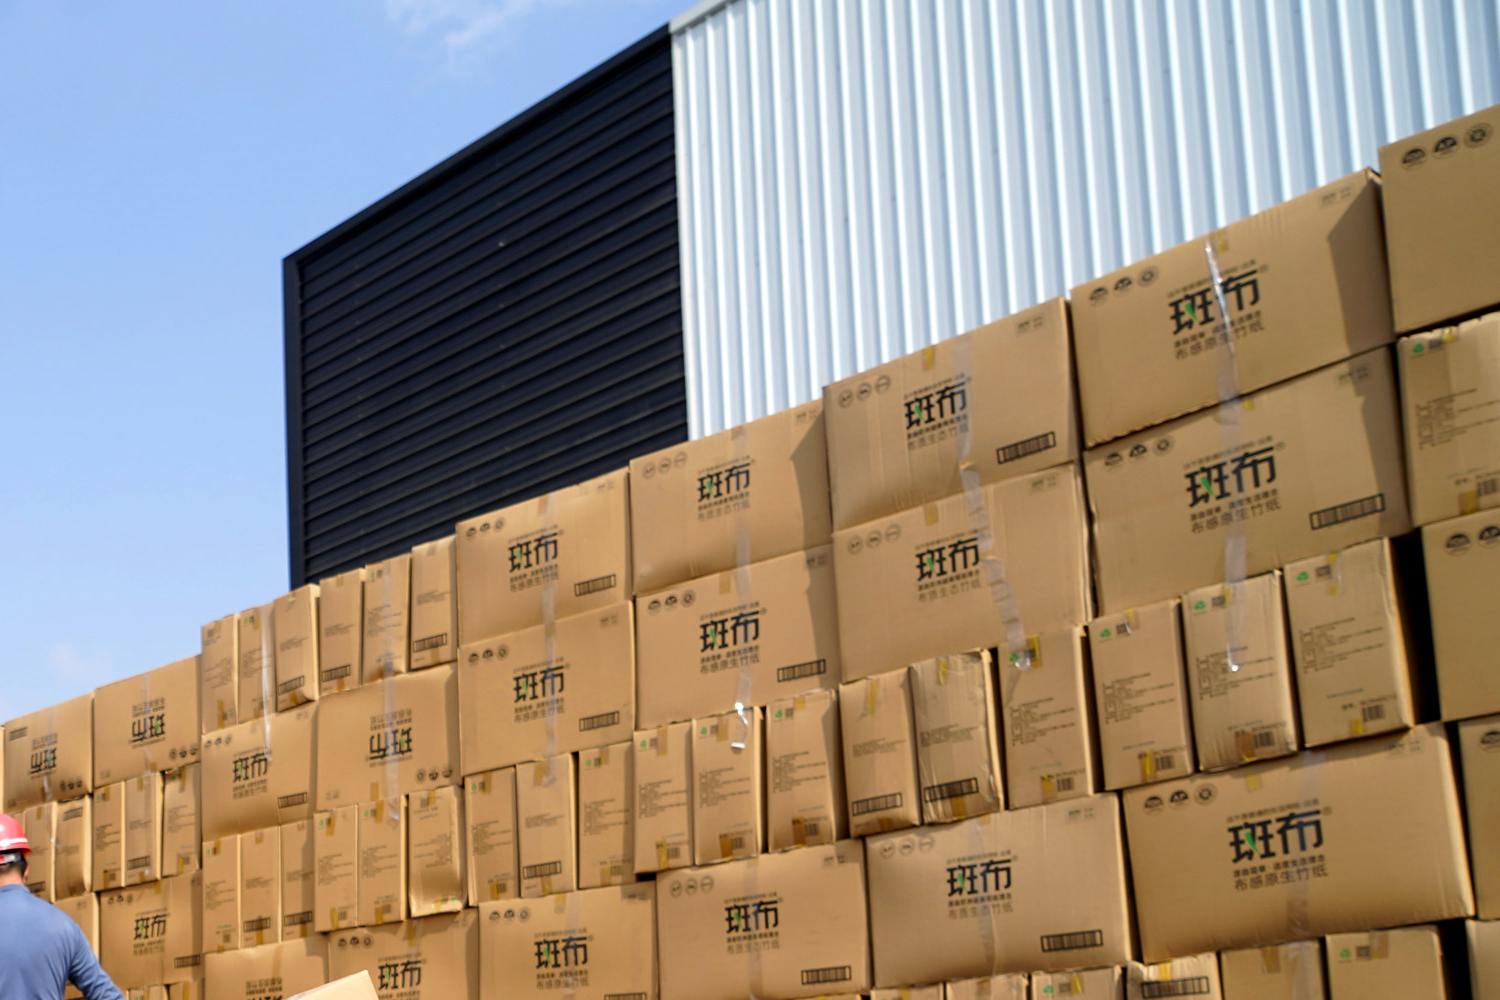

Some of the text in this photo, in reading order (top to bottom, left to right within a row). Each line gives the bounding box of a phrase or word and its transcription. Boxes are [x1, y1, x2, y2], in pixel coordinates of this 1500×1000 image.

[1169, 269, 1259, 335] 斑布
[903, 381, 967, 430] 斑布
[697, 463, 750, 502] 斑布
[1185, 446, 1276, 508] 斑布
[508, 533, 558, 573] 斑布
[915, 537, 980, 582] 斑布
[700, 611, 760, 653] 斑布
[513, 667, 564, 703] 斑布
[233, 753, 268, 783] 斑布
[1228, 810, 1323, 863] 斑布
[946, 859, 1012, 897] 斑布
[133, 914, 169, 940] 斑布
[725, 900, 779, 934] 斑布
[534, 936, 588, 969] 斑布
[378, 960, 422, 991] 斑布
